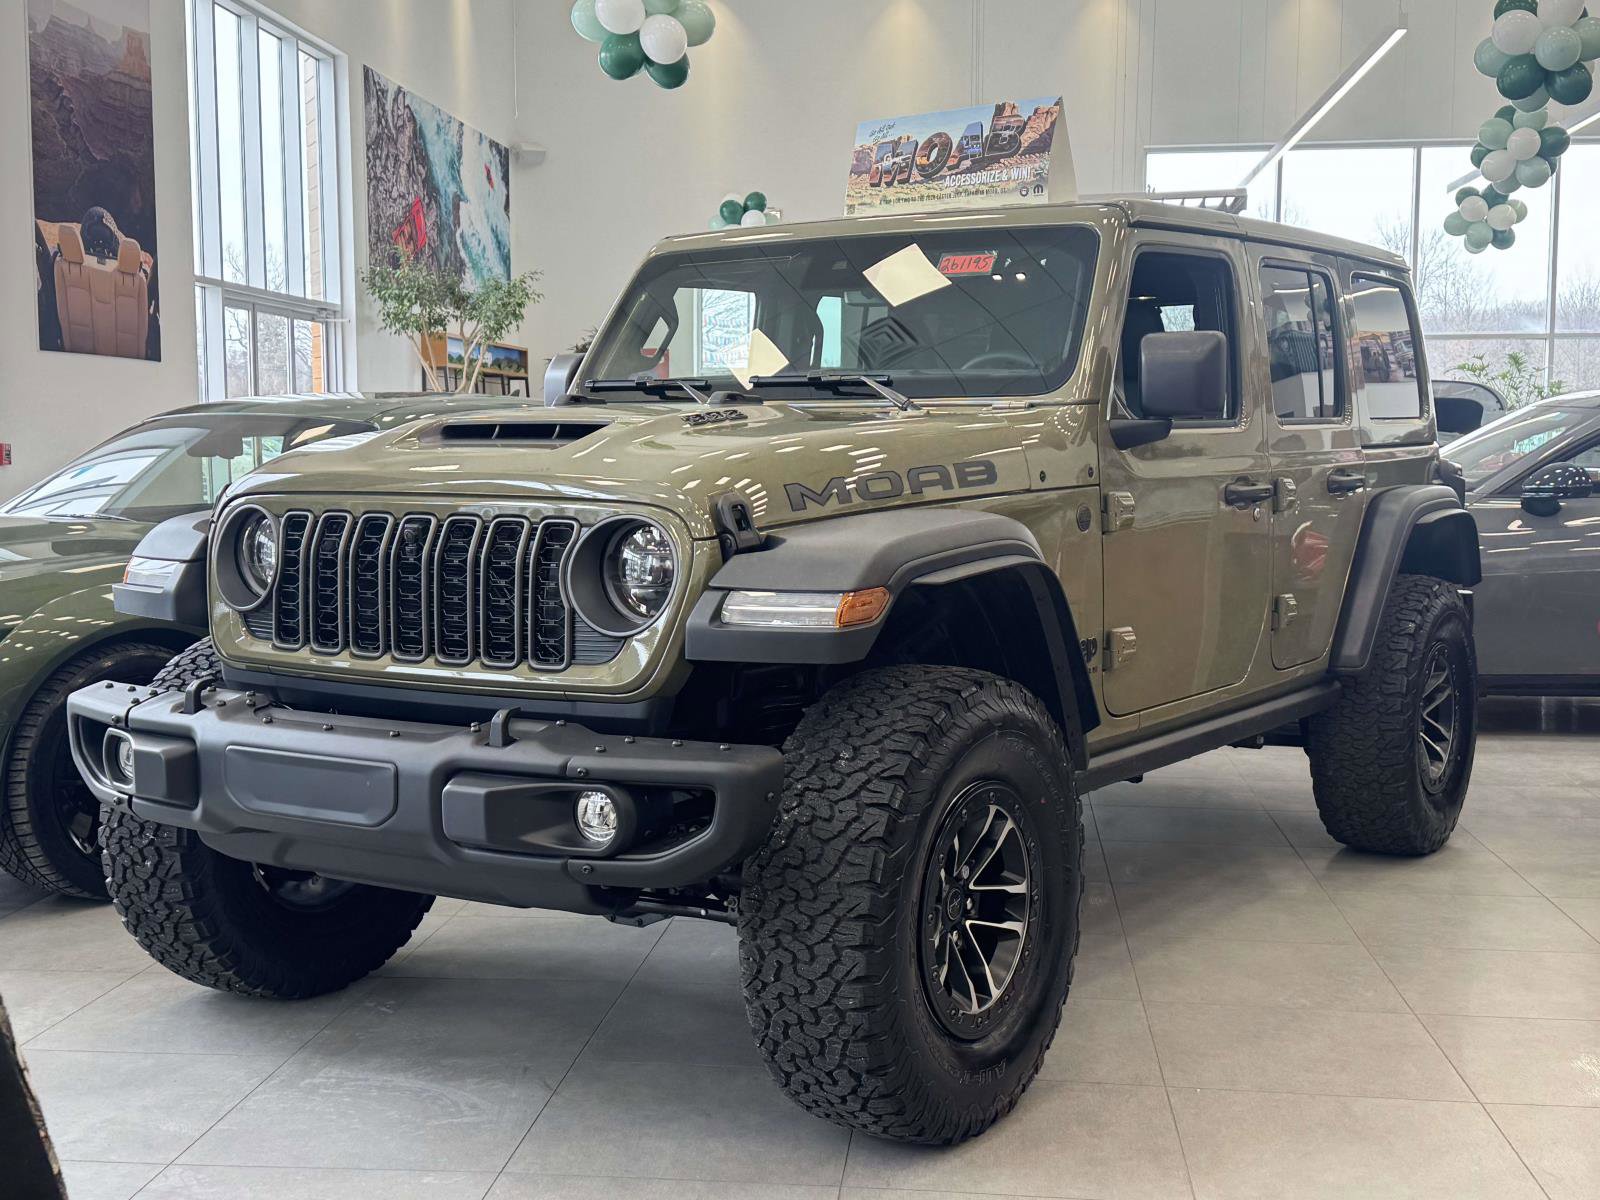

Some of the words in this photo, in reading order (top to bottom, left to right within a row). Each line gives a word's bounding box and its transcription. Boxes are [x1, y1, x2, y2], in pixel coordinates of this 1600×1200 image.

[868, 103, 1026, 187] MOAB
[944, 171, 1000, 188] ACCESSORIZE
[1001, 169, 1008, 181] &
[1010, 166, 1031, 181] WIN!
[941, 256, 993, 272] 261195
[784, 460, 998, 512] MOAB
